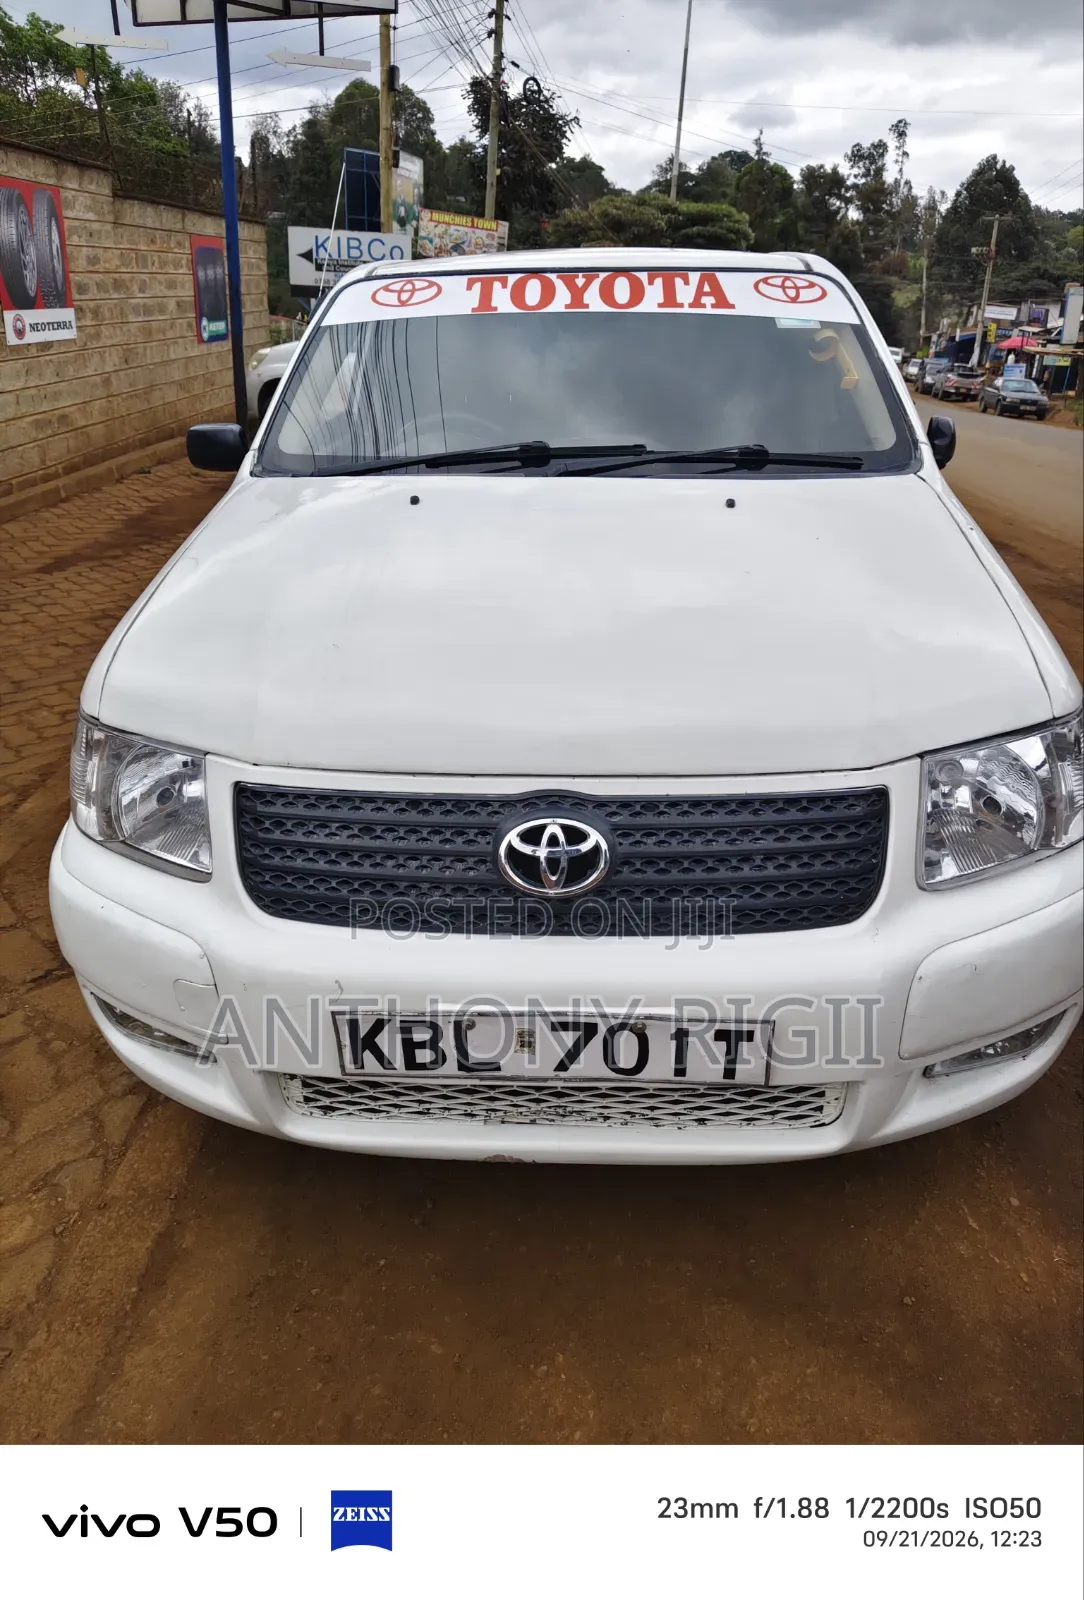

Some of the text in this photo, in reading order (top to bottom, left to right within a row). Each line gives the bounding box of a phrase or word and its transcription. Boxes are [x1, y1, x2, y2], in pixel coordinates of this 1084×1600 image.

[431, 211, 498, 230] MUNCHIES TOWN
[314, 235, 404, 262] KIBCo
[467, 271, 735, 313] TOYOTA
[29, 321, 73, 332] NEOTERRA
